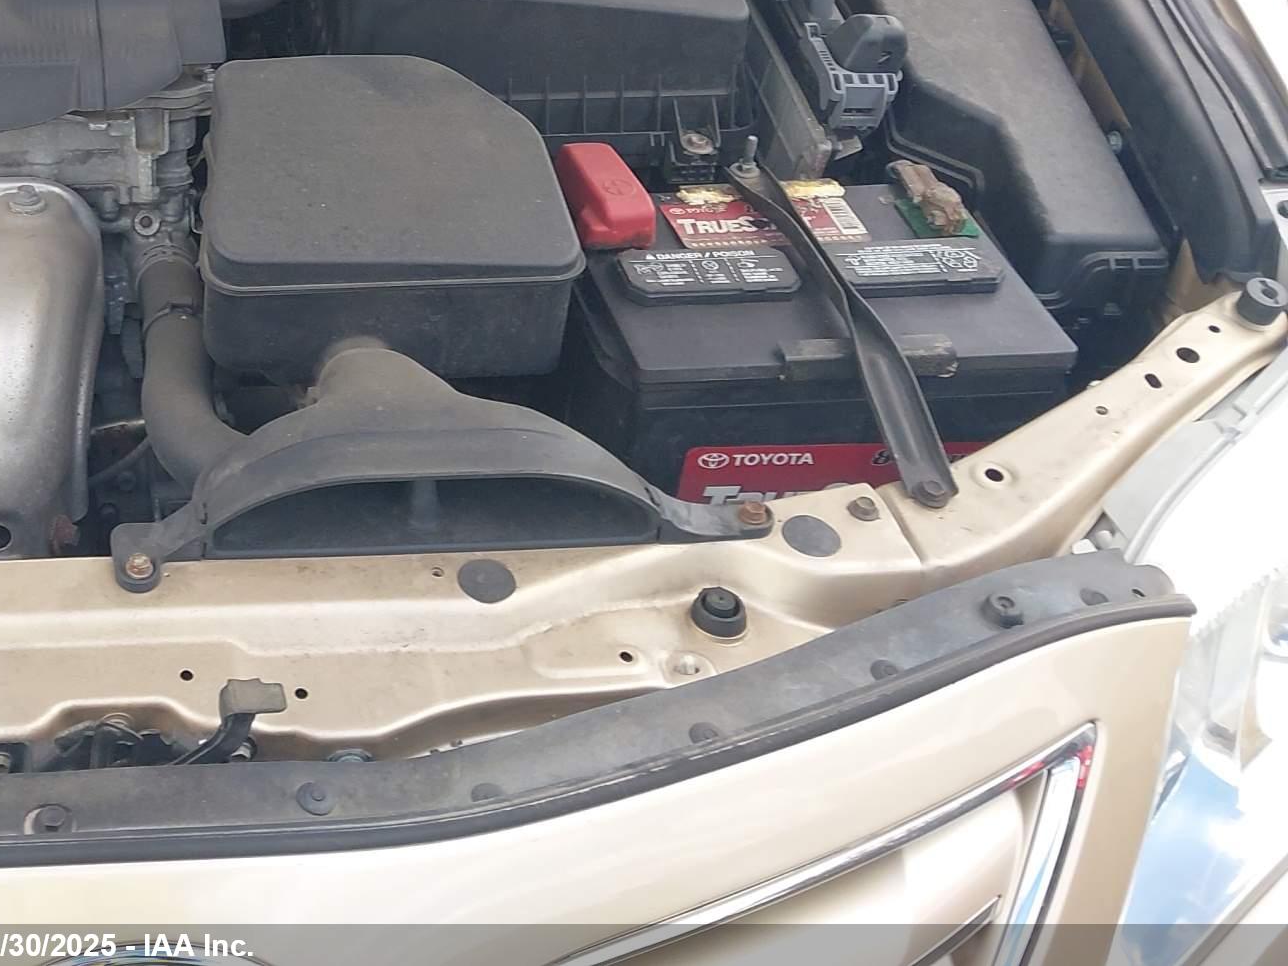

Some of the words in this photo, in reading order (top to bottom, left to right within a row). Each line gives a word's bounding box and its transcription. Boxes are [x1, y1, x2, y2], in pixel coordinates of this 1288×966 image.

[655, 252, 703, 260] DANGER
[711, 250, 756, 258] POISON
[732, 452, 814, 467] TOYOTA
